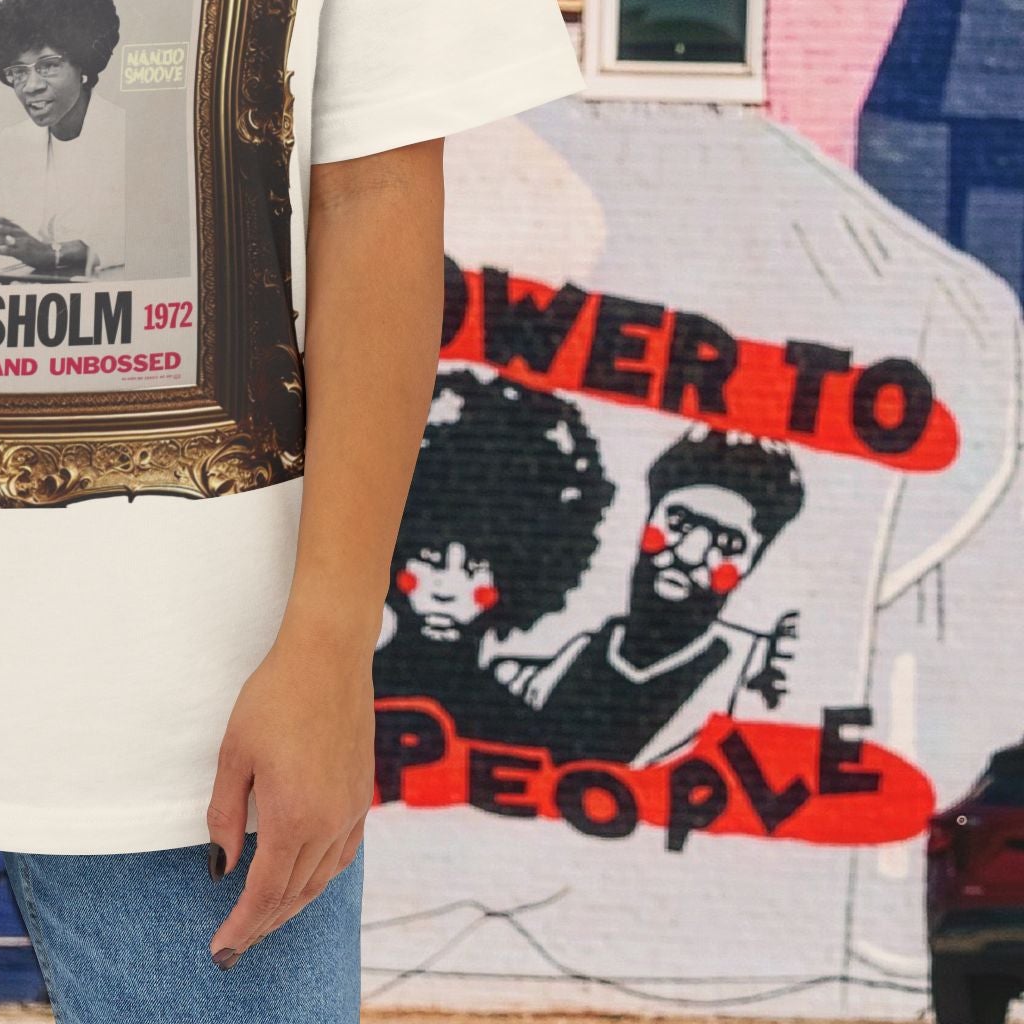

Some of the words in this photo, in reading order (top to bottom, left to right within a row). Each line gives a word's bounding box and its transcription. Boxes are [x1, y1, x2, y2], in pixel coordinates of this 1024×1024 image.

[127, 48, 185, 66] NANDO
[124, 65, 184, 84] SMOOVE
[144, 301, 193, 330] 1972
[50, 352, 182, 376] UNBOSSED
[785, 339, 934, 455] TO
[373, 706, 880, 852] PEOPLE
